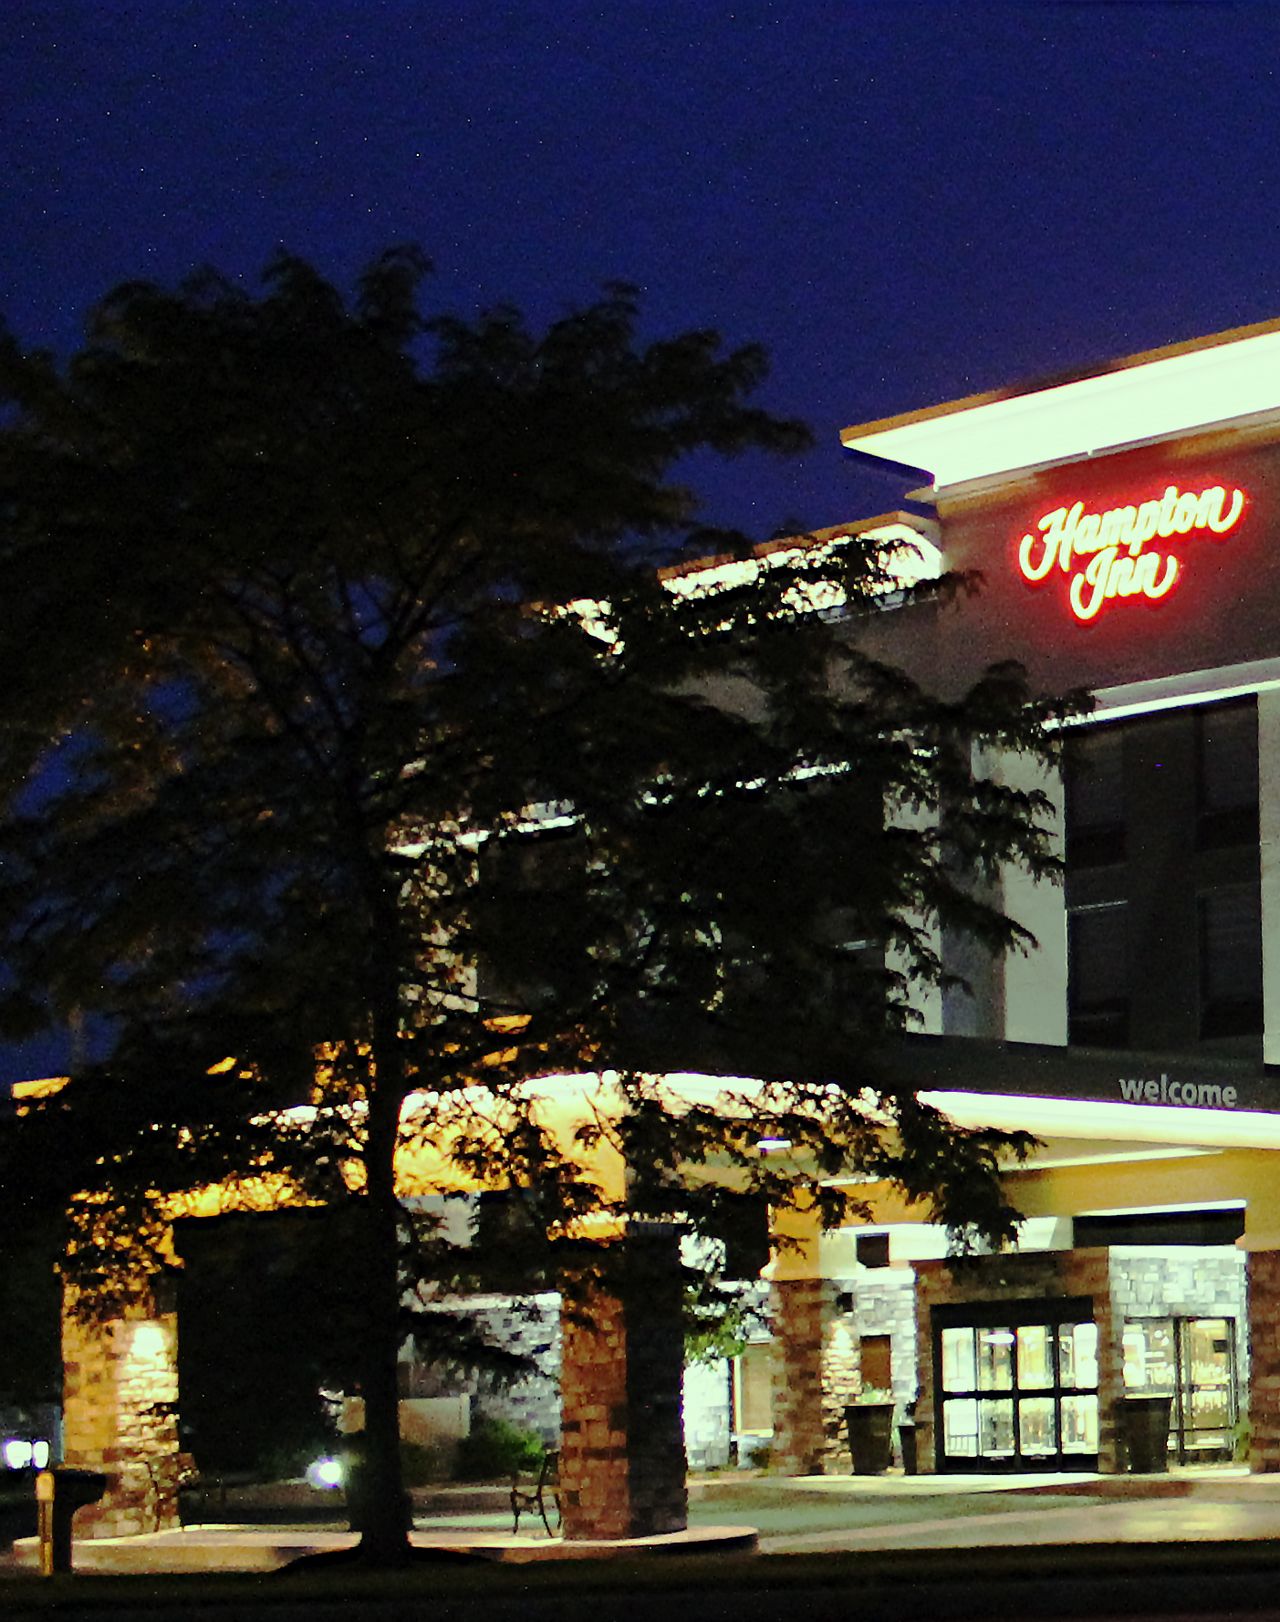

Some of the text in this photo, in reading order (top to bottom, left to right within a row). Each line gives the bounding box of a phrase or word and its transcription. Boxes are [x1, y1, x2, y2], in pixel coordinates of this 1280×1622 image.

[1018, 485, 1245, 581] Hampton
[1069, 546, 1180, 620] Inn
[1118, 1073, 1238, 1108] welcome
